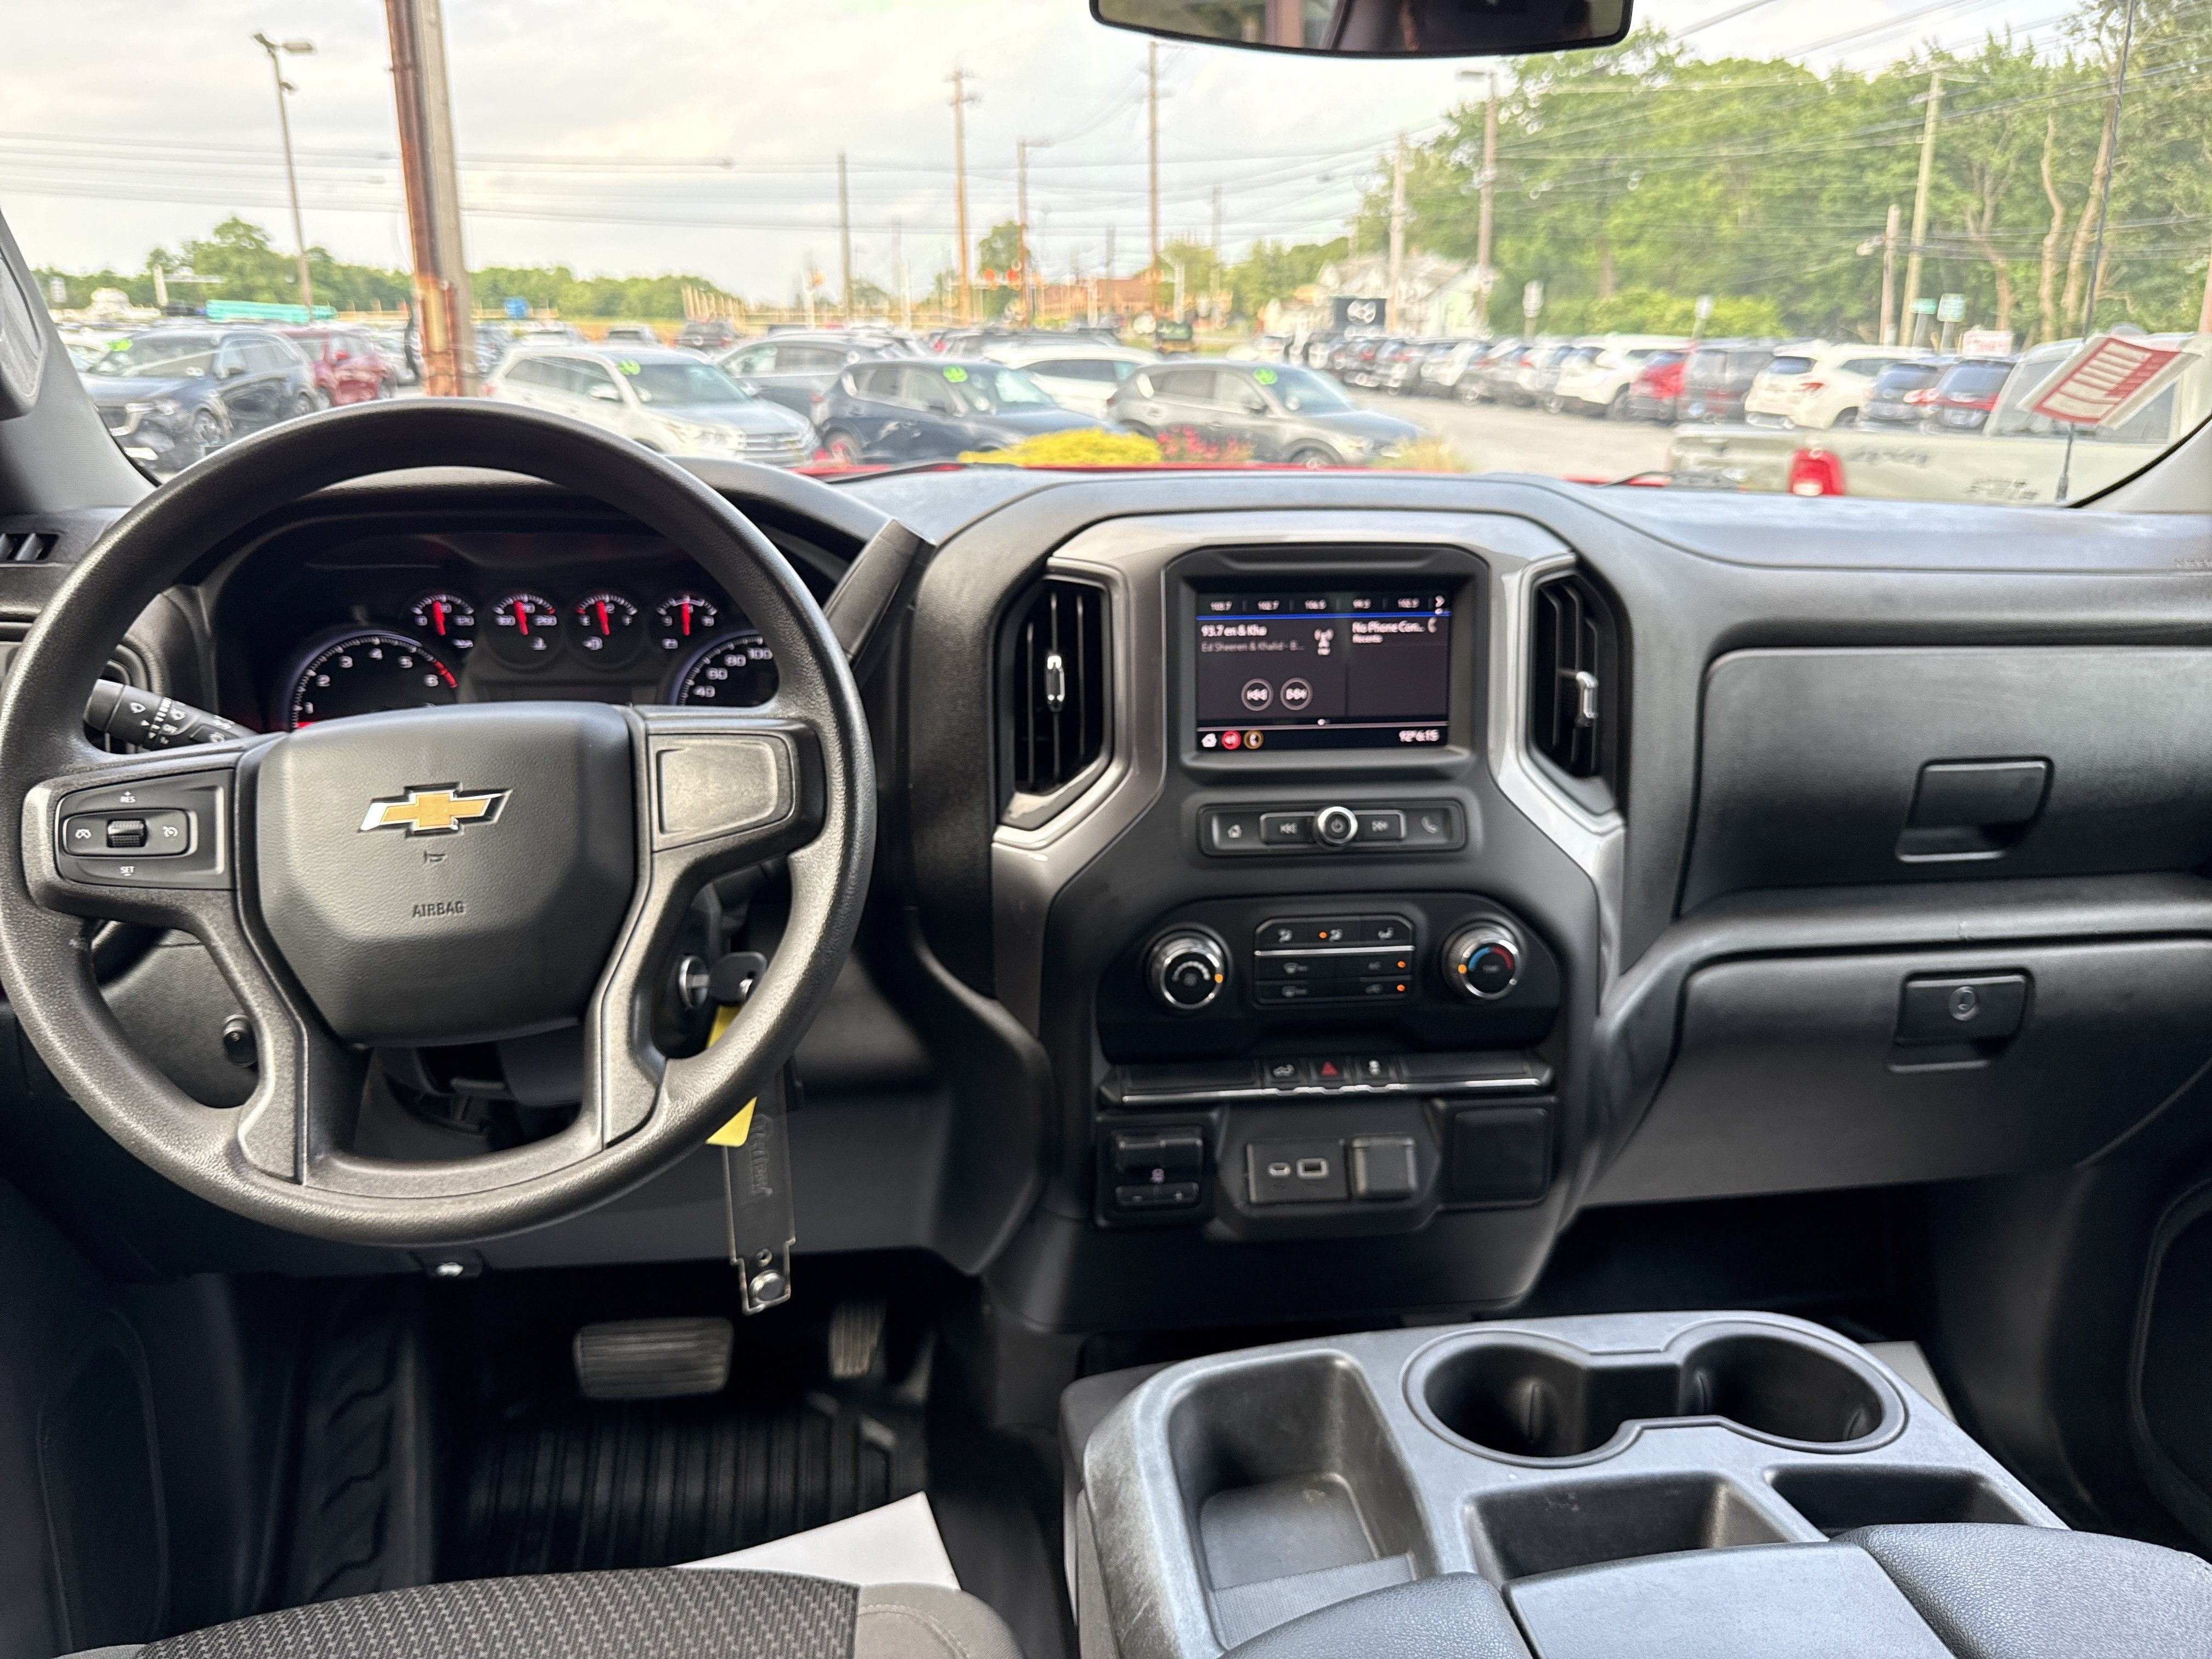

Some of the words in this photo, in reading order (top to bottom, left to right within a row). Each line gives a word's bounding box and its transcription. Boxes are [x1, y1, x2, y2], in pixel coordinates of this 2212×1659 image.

[1201, 624, 1224, 637] 93.7
[1352, 621, 1367, 633] No
[1368, 620, 1398, 633] Phone
[369, 648, 383, 660] 4
[747, 647, 773, 660] 100
[340, 656, 353, 668] 3
[398, 656, 413, 668] 5
[724, 654, 747, 667] 80
[706, 668, 729, 680] 60
[317, 674, 330, 687] 2
[424, 674, 438, 687] 6
[693, 686, 715, 698] 40
[305, 702, 314, 714] 1
[120, 866, 135, 874] SET
[412, 900, 466, 918] AIRBAG
